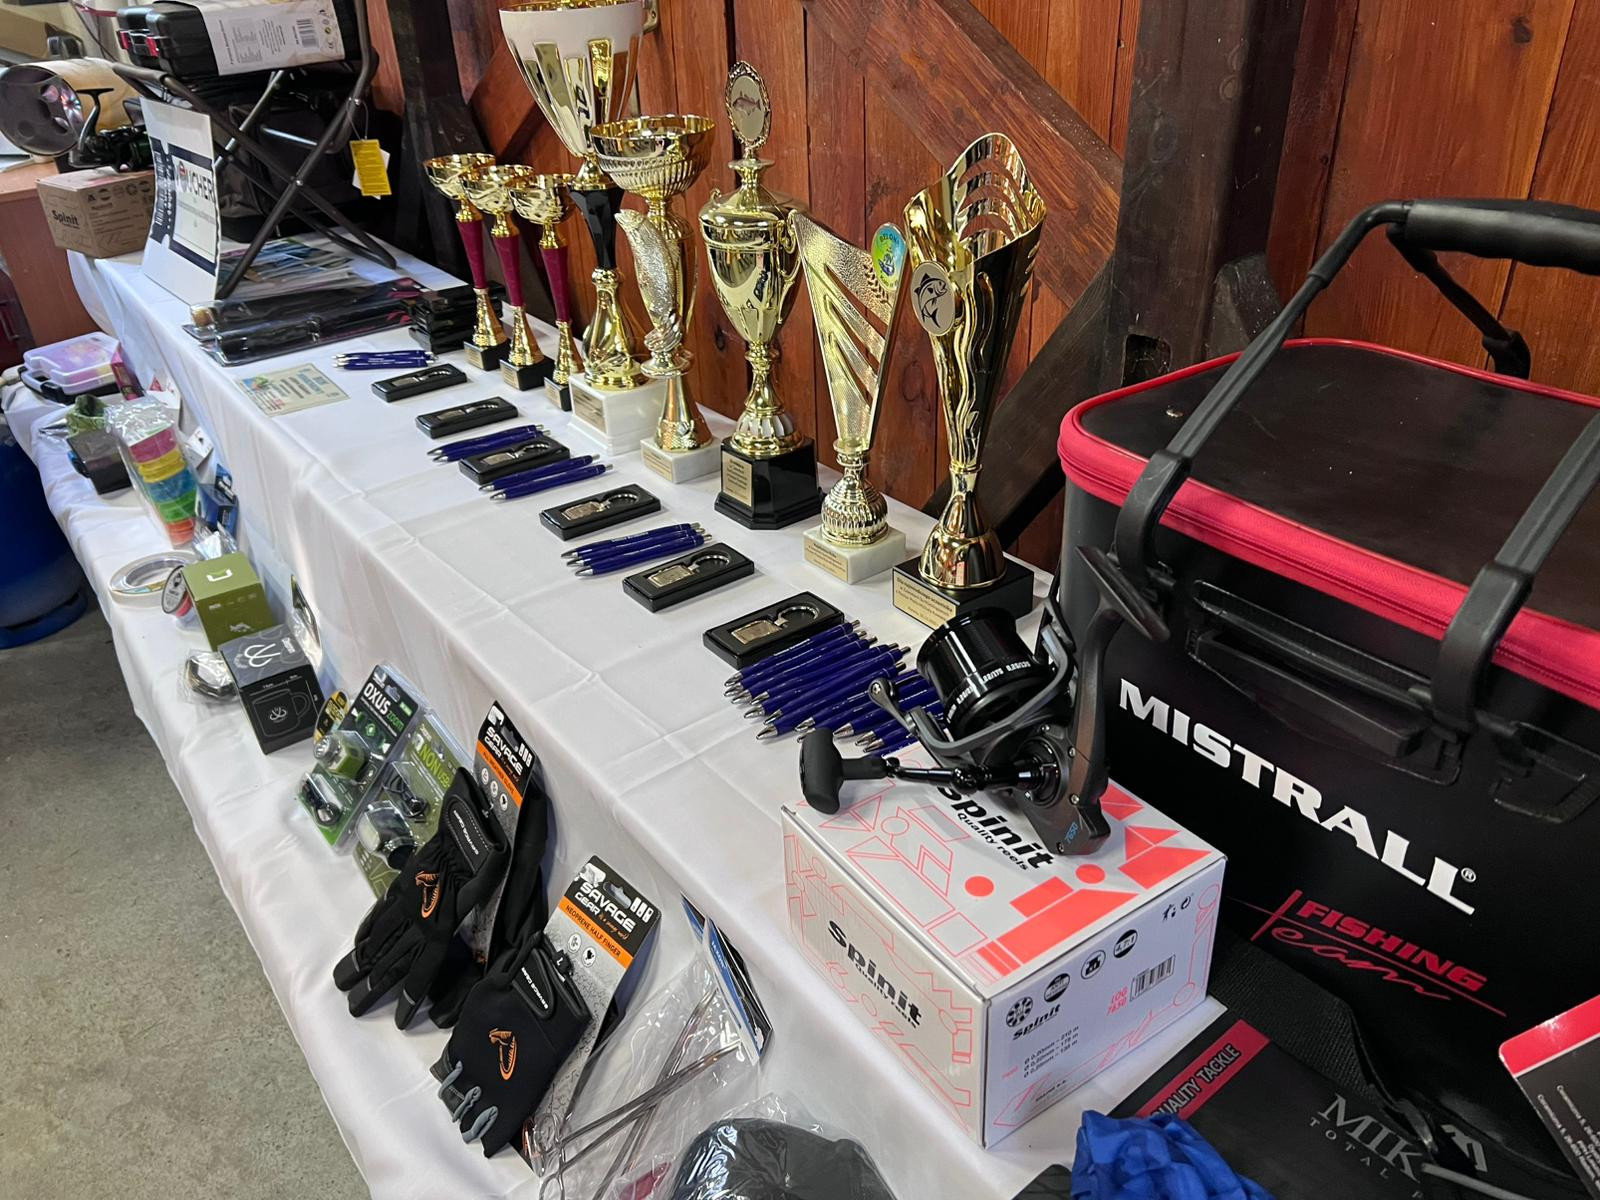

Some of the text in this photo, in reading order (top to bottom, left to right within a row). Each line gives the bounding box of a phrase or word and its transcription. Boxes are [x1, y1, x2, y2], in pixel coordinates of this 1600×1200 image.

[52, 209, 79, 226] Spinit
[363, 682, 391, 716] OXUS
[484, 735, 502, 759] GEAR
[486, 726, 523, 776] SAVAGE
[996, 845, 1029, 871] reels
[574, 891, 601, 916] GEAR
[579, 881, 637, 934] SAVAGE
[565, 904, 621, 958] NEOPRENE HALF FINGER
[1296, 900, 1488, 992] FISHING
[828, 920, 922, 1027] Spinit
[1013, 1003, 1061, 1040] Spinit
[1195, 1044, 1240, 1083] TACKLE
[1309, 1116, 1389, 1179] TOTAL
[1317, 1093, 1424, 1184] MIK
